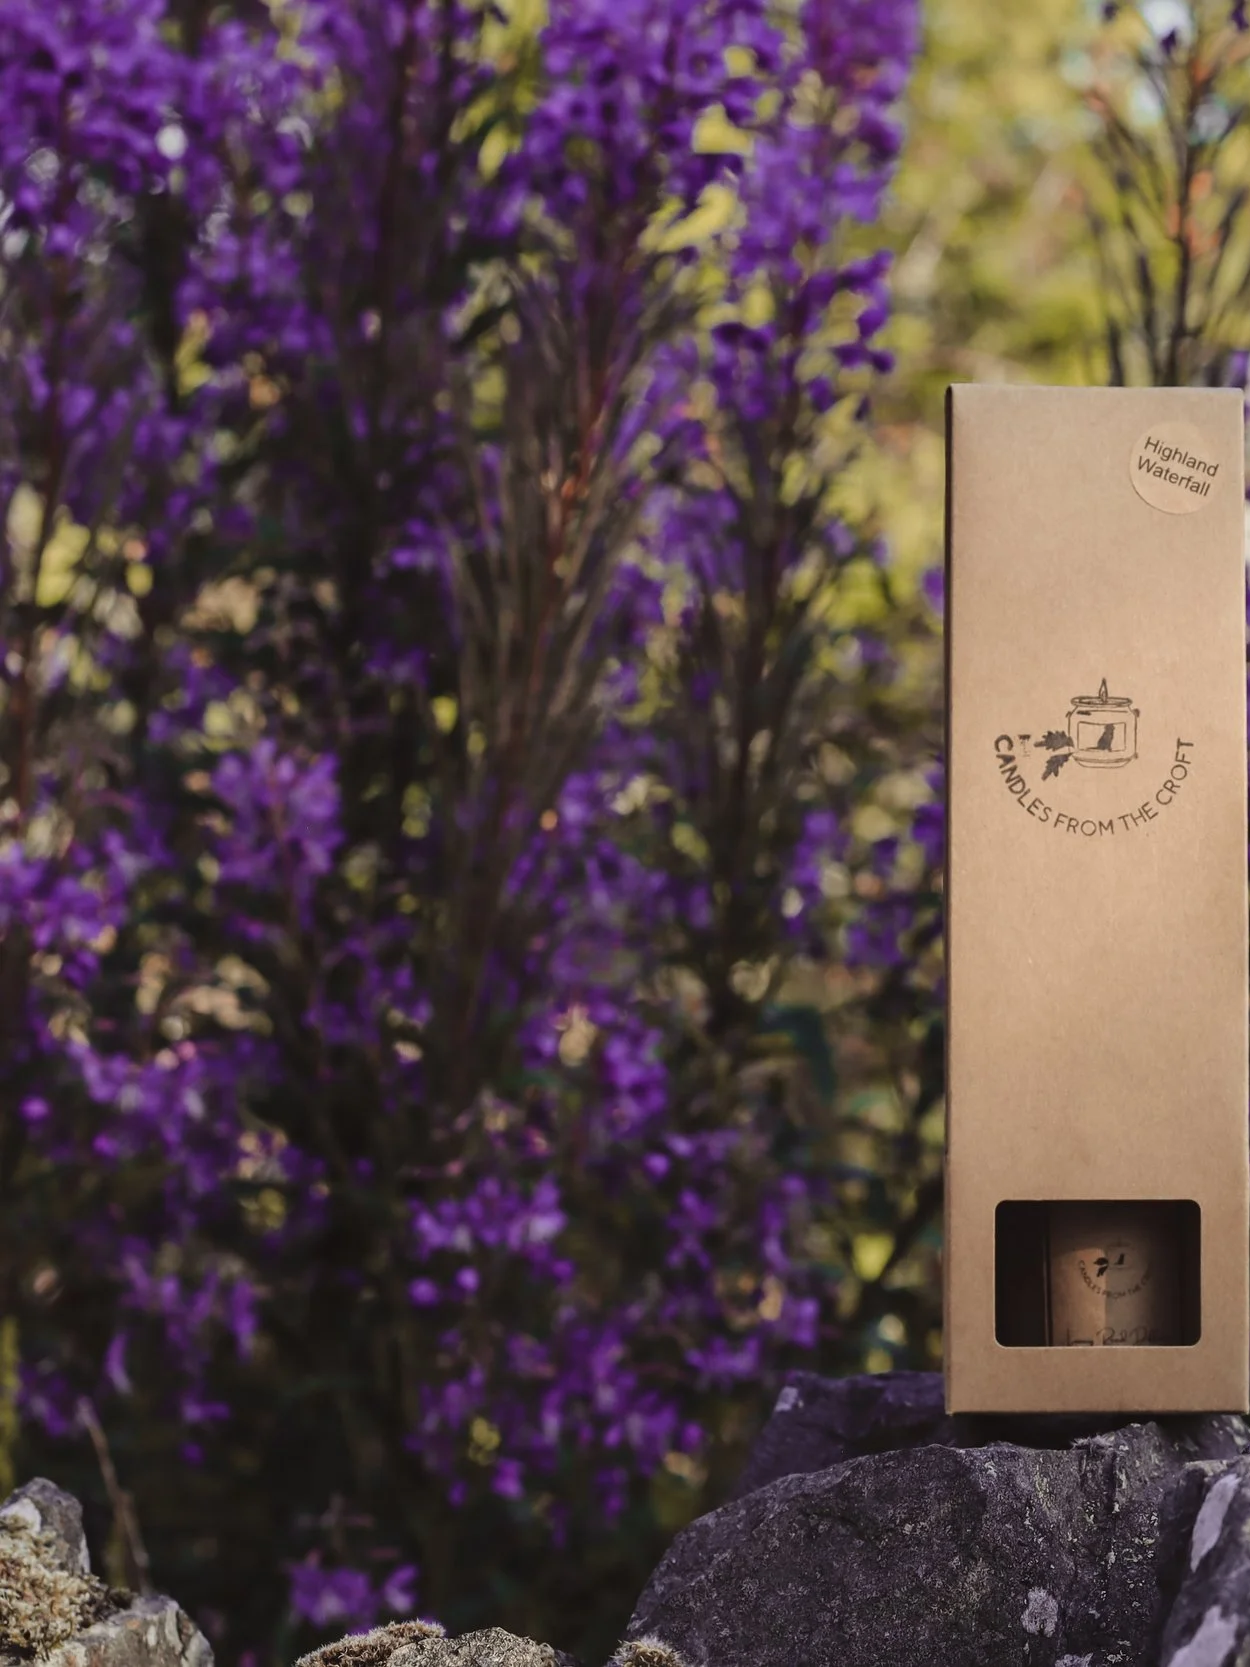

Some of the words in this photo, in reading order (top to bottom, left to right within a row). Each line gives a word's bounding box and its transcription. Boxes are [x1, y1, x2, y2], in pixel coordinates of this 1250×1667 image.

[1138, 455, 1211, 496] Waterfall
[1144, 436, 1219, 477] Highland
[994, 734, 1052, 823] CANDLES
[1053, 812, 1115, 836] FROM
[1118, 802, 1159, 831] THE
[1156, 737, 1194, 806] CROFT
